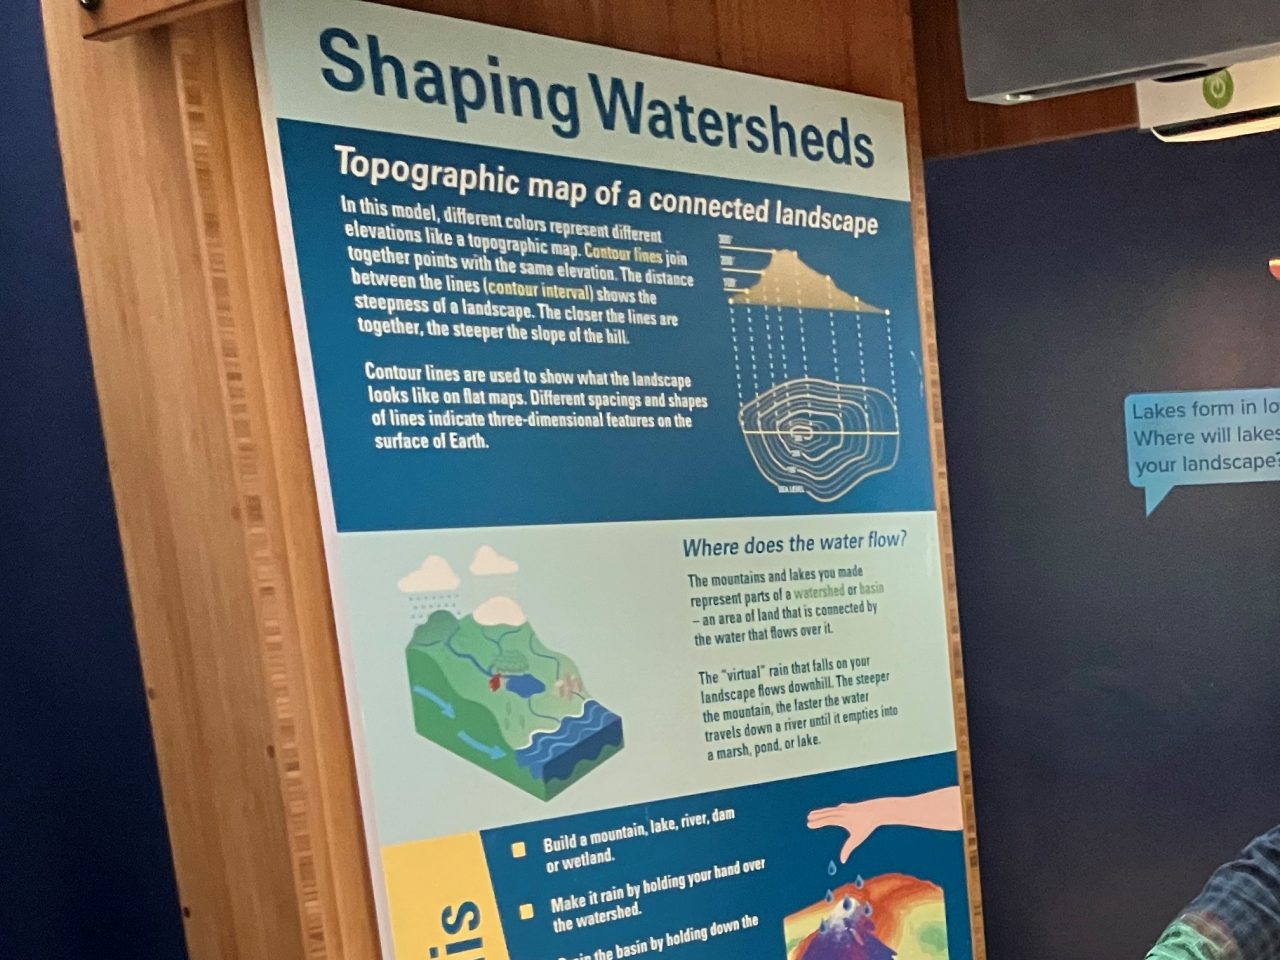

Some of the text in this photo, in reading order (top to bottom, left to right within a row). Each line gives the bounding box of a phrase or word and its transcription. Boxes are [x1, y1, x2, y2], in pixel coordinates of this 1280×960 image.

[319, 27, 875, 168] Shaping Watersheds
[334, 144, 879, 239] Topographic map of a connected landscape
[340, 194, 663, 244] In this model, different colors represent different
[344, 219, 688, 268] elevations like a topographic map. Contour lines join
[364, 361, 692, 392] Contour lines are used to show what the landscape
[1132, 403, 1186, 420] Lakes
[1191, 400, 1234, 417] form
[1241, 398, 1257, 415] in
[374, 431, 490, 449] surface of Earth.
[1133, 429, 1195, 447] Where
[1200, 426, 1231, 444] will
[1135, 460, 1177, 478] your
[683, 529, 908, 558] Where does the water flow?
[687, 564, 864, 588] The mountains and lakes you made
[543, 808, 736, 854] Build a mountain, lake, river, dam
[546, 847, 616, 874] or wetland.
[615, 939, 648, 959] basin
[649, 936, 664, 953] by
[665, 927, 708, 947] holding
[709, 920, 740, 937] down
[741, 914, 759, 929] the
